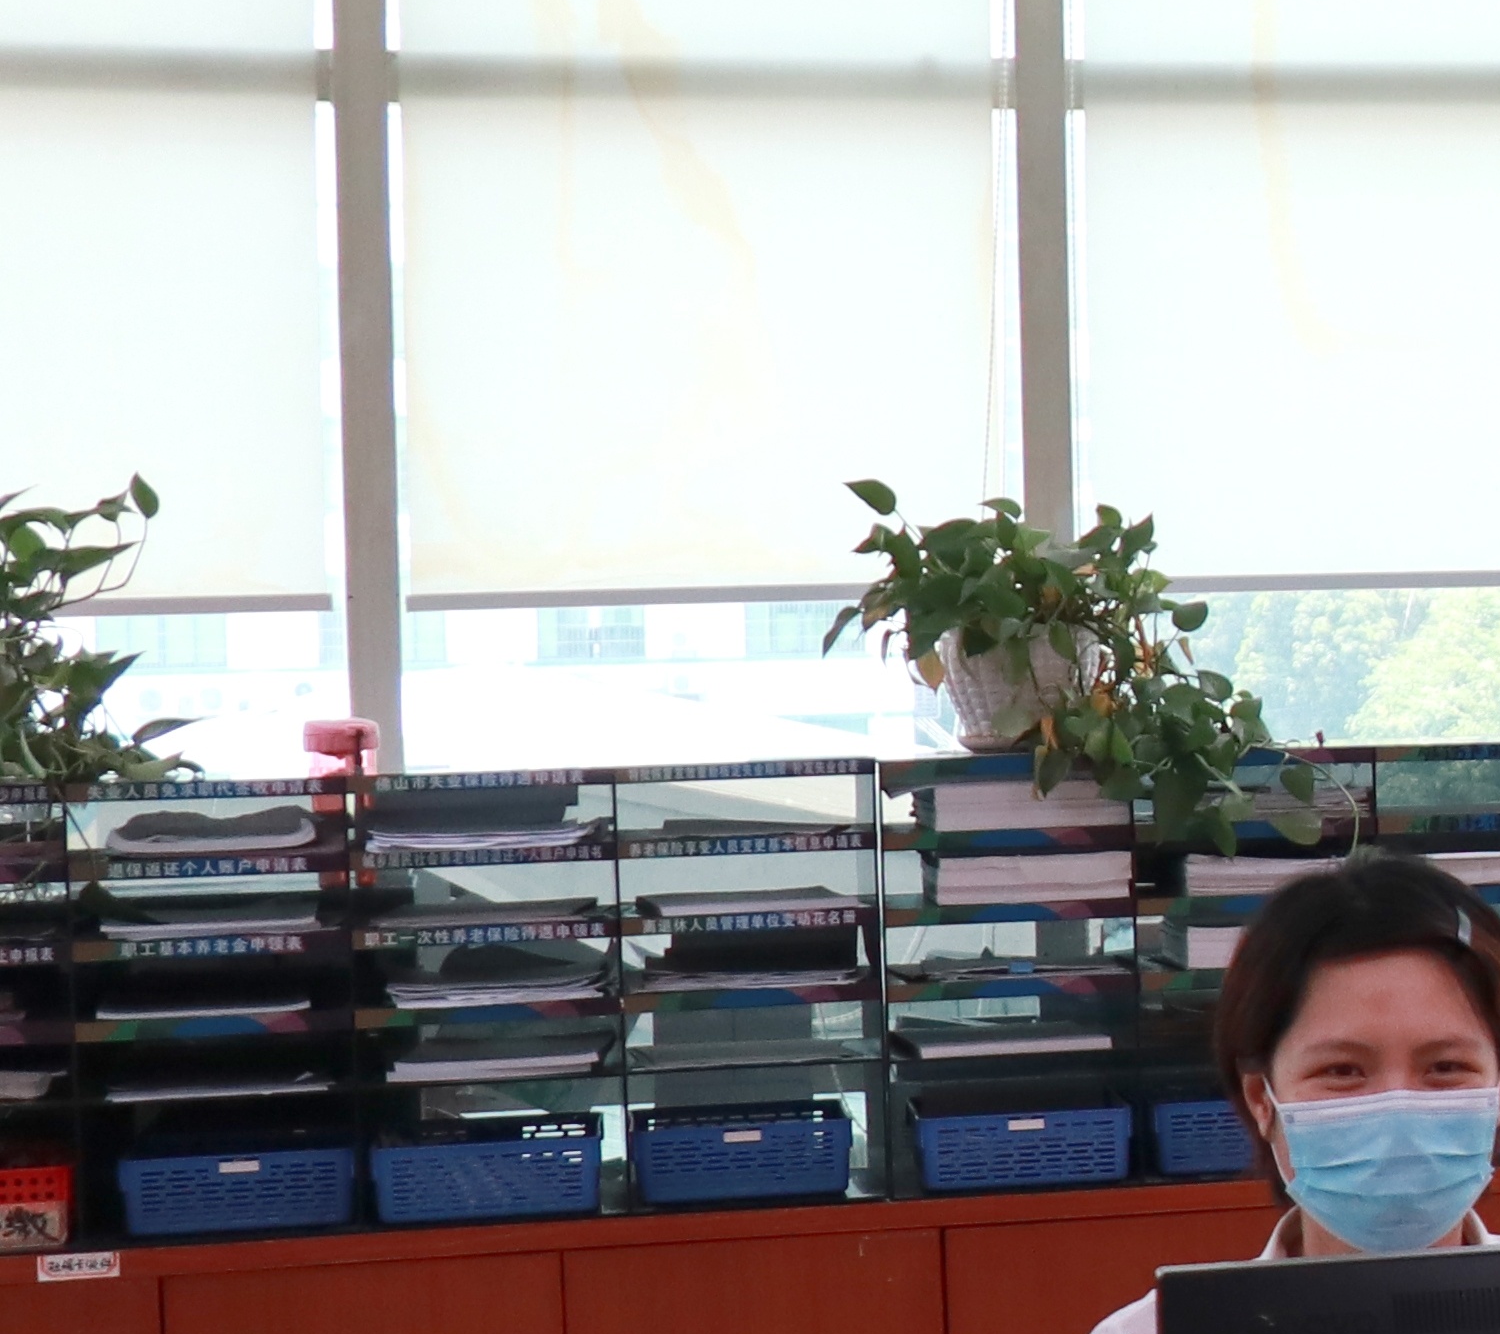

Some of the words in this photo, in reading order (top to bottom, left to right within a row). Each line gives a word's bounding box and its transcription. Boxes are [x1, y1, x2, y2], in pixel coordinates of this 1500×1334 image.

[120, 936, 304, 958] 职工基本养老金申领表
